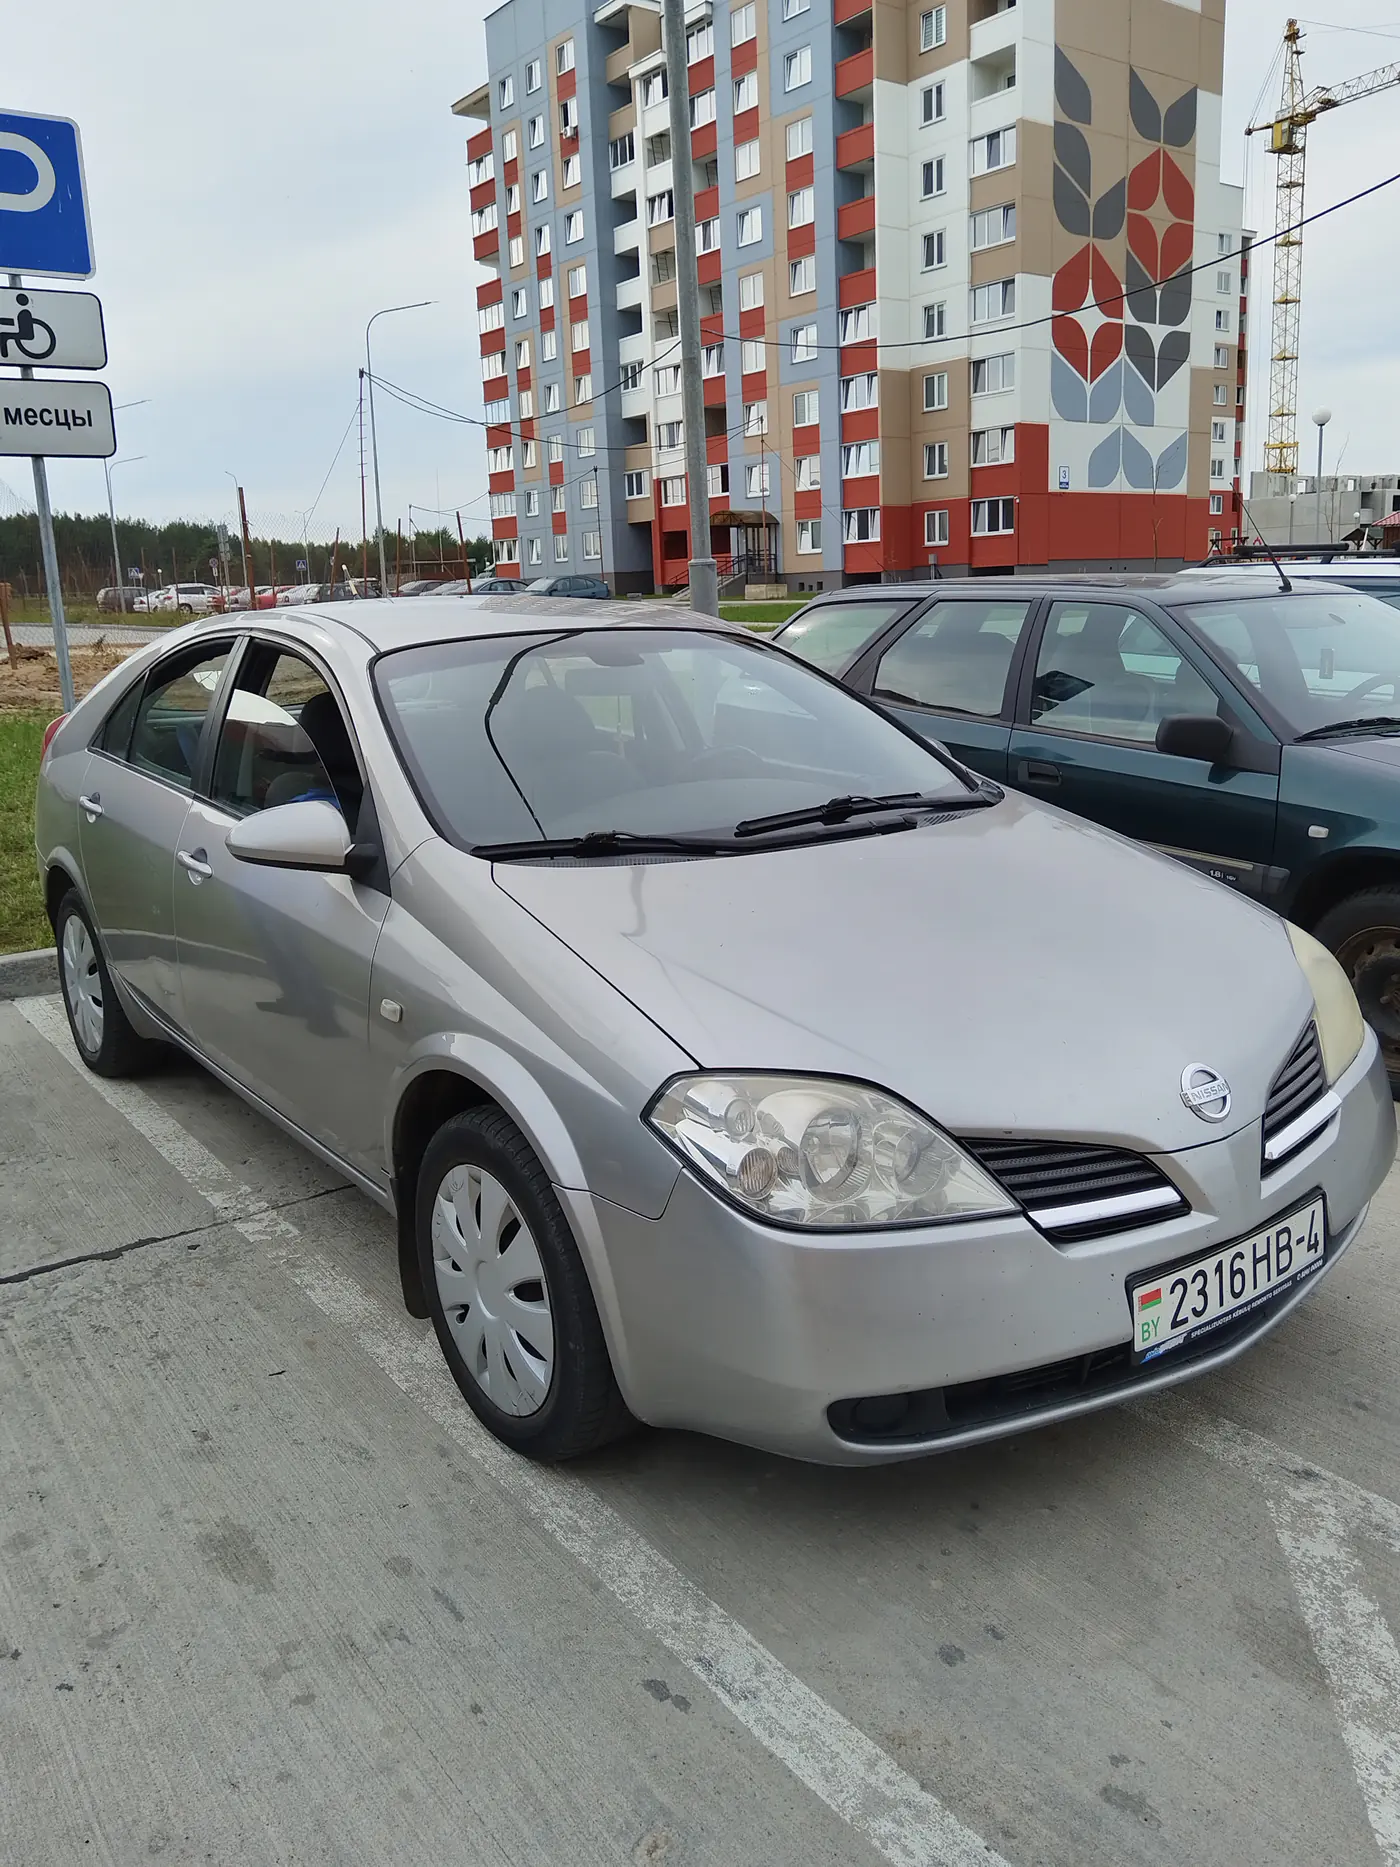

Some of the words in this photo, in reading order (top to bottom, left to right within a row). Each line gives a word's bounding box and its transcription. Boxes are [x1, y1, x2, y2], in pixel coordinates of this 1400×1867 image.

[3, 406, 93, 431] месцы
[1061, 469, 1067, 480] 3
[1190, 1082, 1229, 1102] NISSAN
[1141, 1316, 1161, 1343] BY
